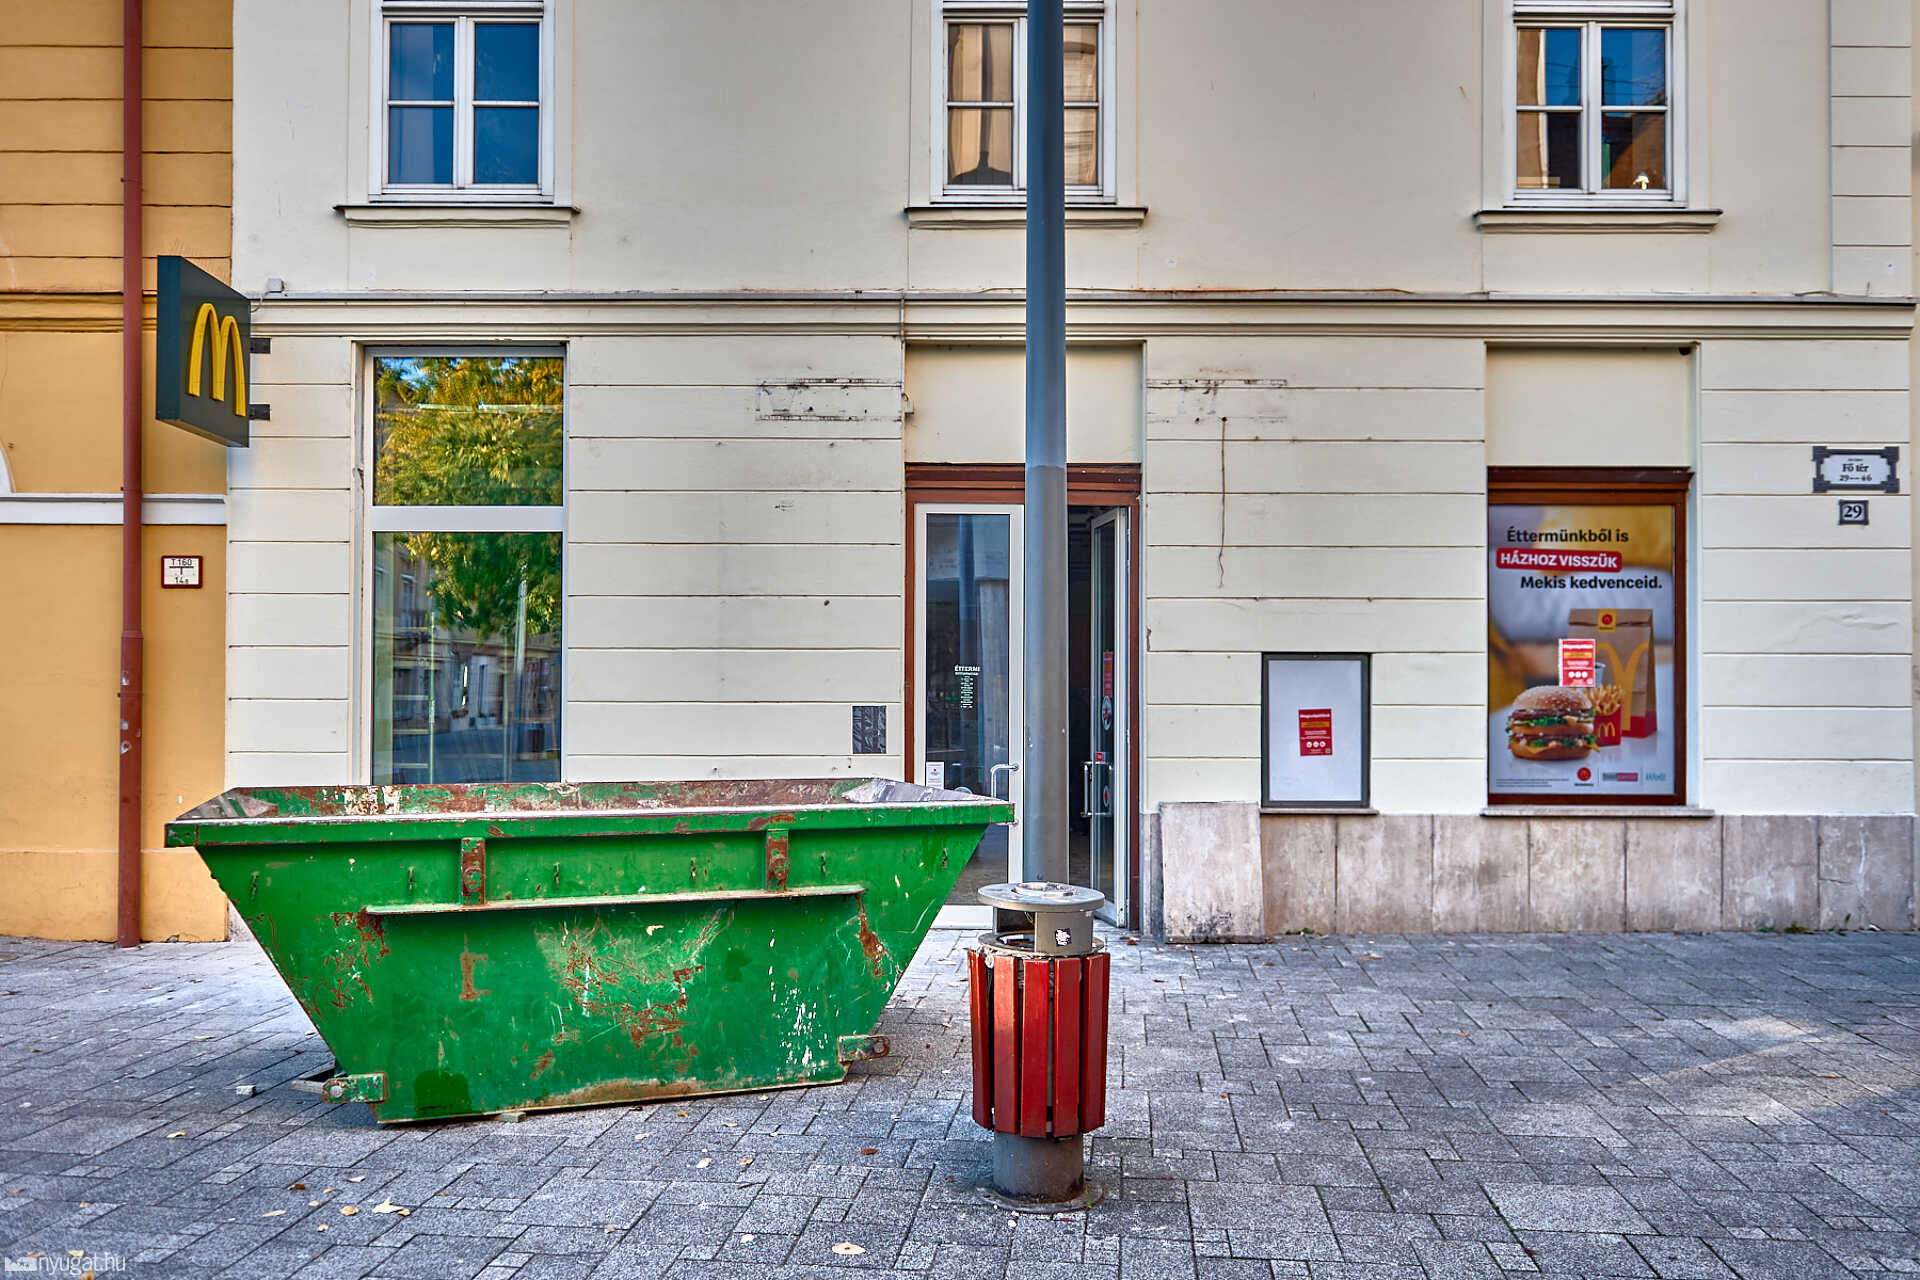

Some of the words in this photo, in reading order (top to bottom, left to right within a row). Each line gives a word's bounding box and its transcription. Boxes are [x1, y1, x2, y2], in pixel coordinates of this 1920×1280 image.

[1844, 505, 1863, 519] 29
[1506, 526, 1612, 543] Éttermünkből
[1616, 530, 1629, 543] is
[1500, 550, 1557, 566] HÁZHOZ
[1559, 553, 1618, 569] VISSZÜK
[1520, 576, 1566, 589] Mekis
[1570, 576, 1663, 589] kedvenceid.
